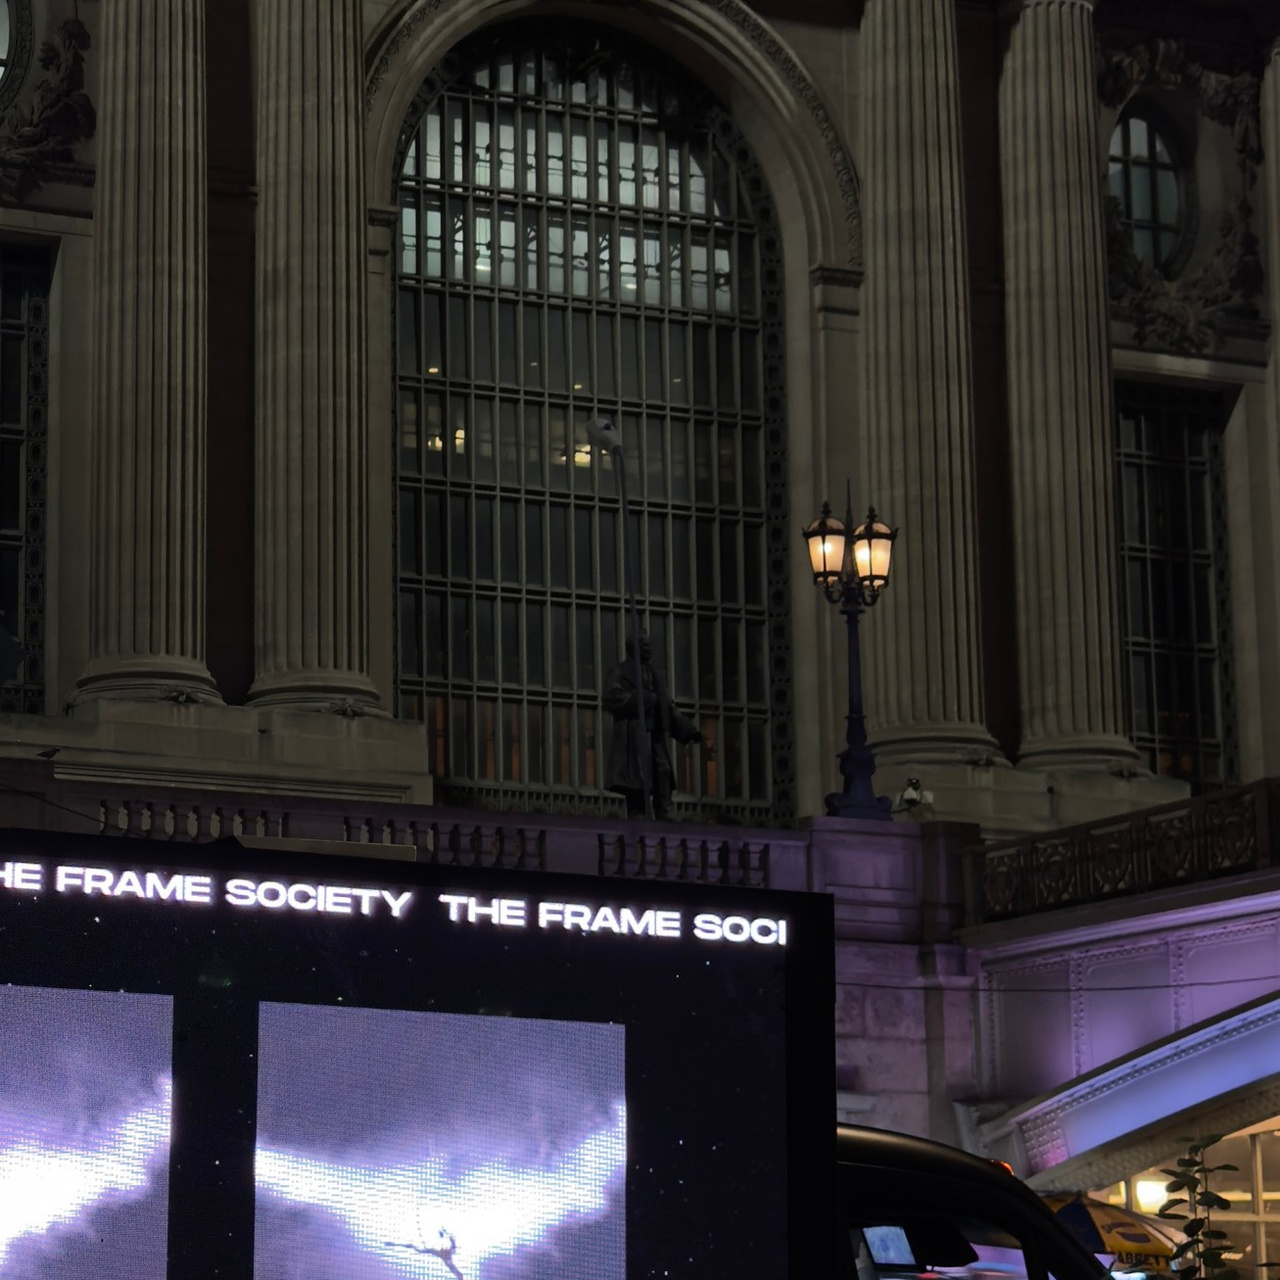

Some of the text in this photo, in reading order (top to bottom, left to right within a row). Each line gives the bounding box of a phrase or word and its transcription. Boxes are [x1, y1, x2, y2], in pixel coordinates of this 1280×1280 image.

[55, 865, 214, 904] FRAME
[224, 878, 413, 918] SOCIETY
[437, 893, 527, 927] THE
[538, 901, 682, 938] FRAME
